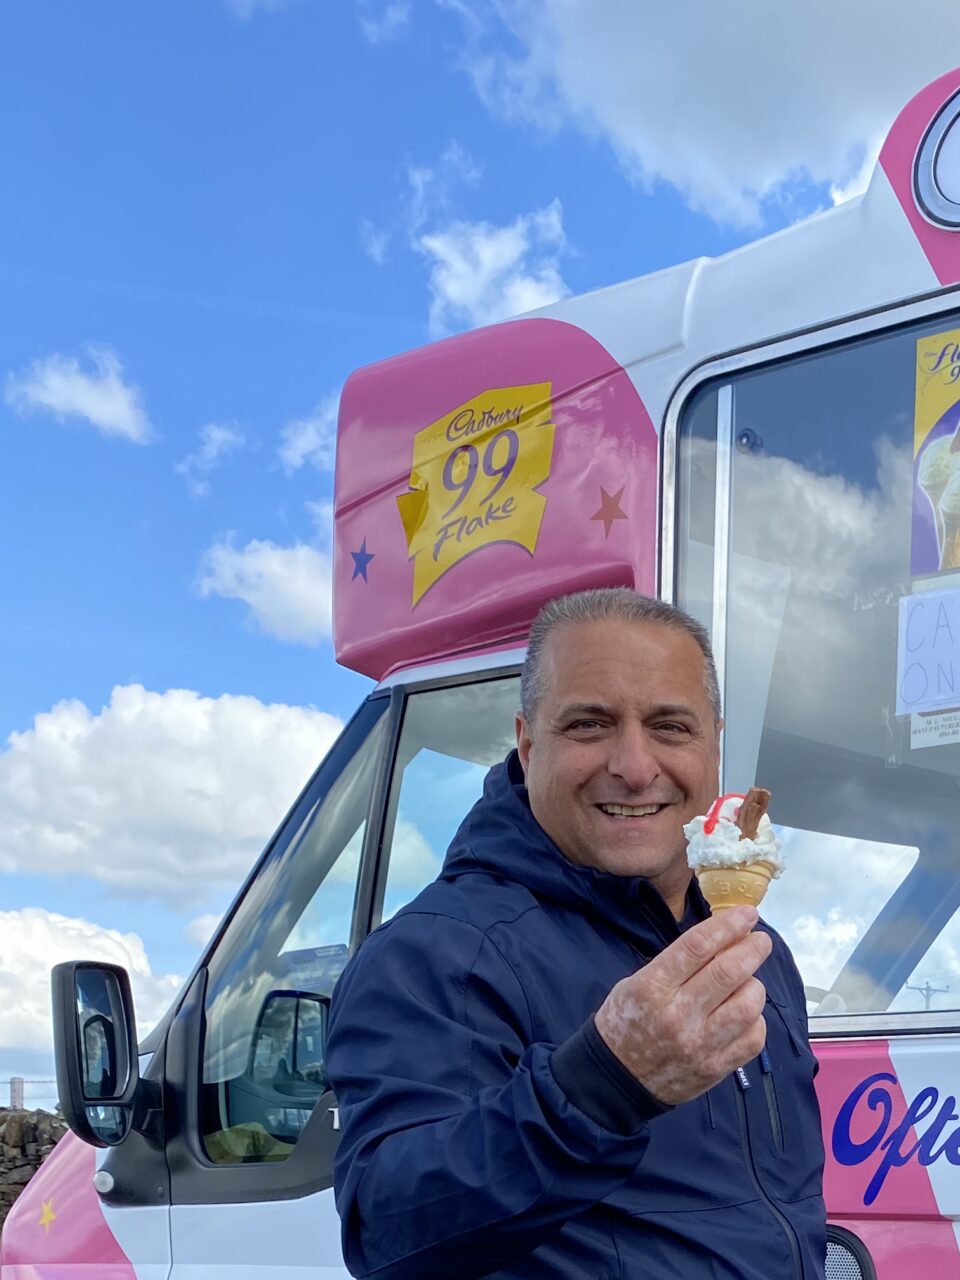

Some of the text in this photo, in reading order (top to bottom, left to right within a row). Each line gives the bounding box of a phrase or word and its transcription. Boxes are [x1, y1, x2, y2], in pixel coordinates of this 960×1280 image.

[445, 405, 524, 442] Cadbury
[442, 429, 520, 519] 99
[432, 496, 518, 561] Flake
